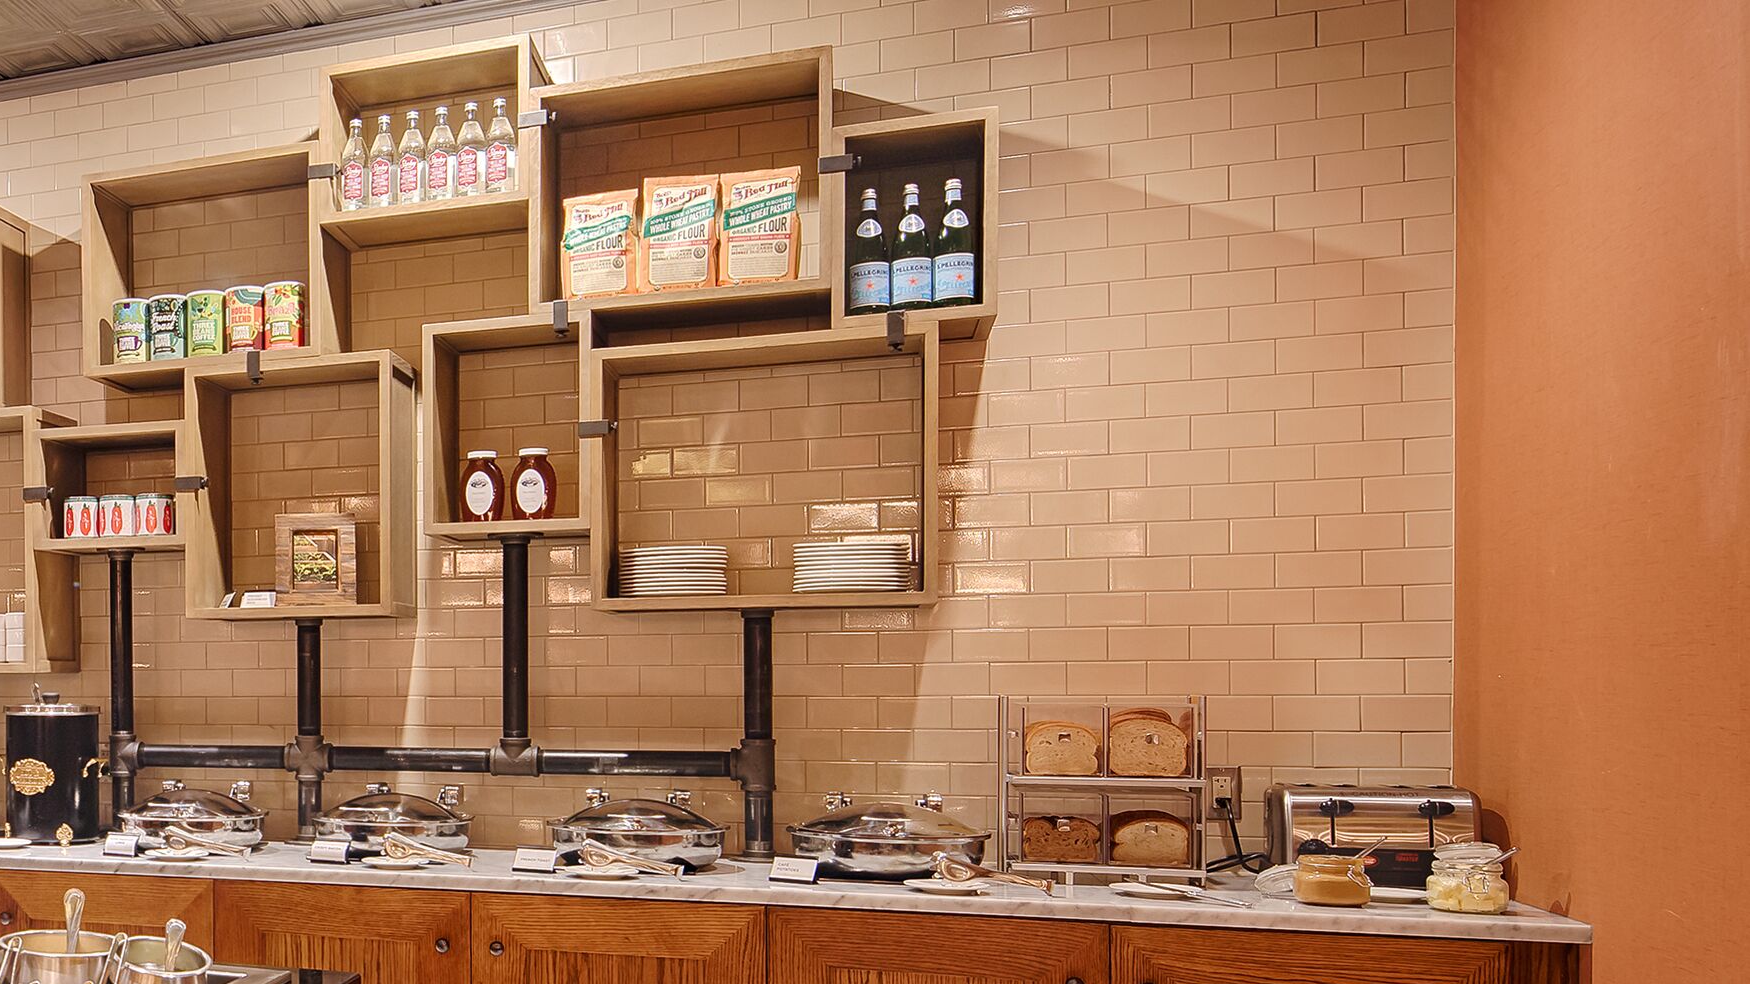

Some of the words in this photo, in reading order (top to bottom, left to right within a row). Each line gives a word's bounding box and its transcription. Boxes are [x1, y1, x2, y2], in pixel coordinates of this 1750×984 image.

[665, 193, 685, 207] Red
[687, 187, 707, 201] Mill
[744, 185, 765, 199] Red
[650, 223, 670, 235] WHOLE
[670, 216, 689, 229] WHEAT
[689, 208, 710, 223] PASTRY
[729, 213, 750, 226] WHOLE
[750, 207, 769, 220] WHEAT
[770, 201, 793, 216] PASTRY
[653, 233, 677, 242] ORGANIC
[677, 223, 706, 240] FLOUR
[732, 225, 757, 235] ORGANIC
[757, 216, 787, 233] FLOUR
[595, 234, 623, 251] FLOUR
[232, 306, 252, 315] HOUSE
[232, 315, 252, 324] BLEND
